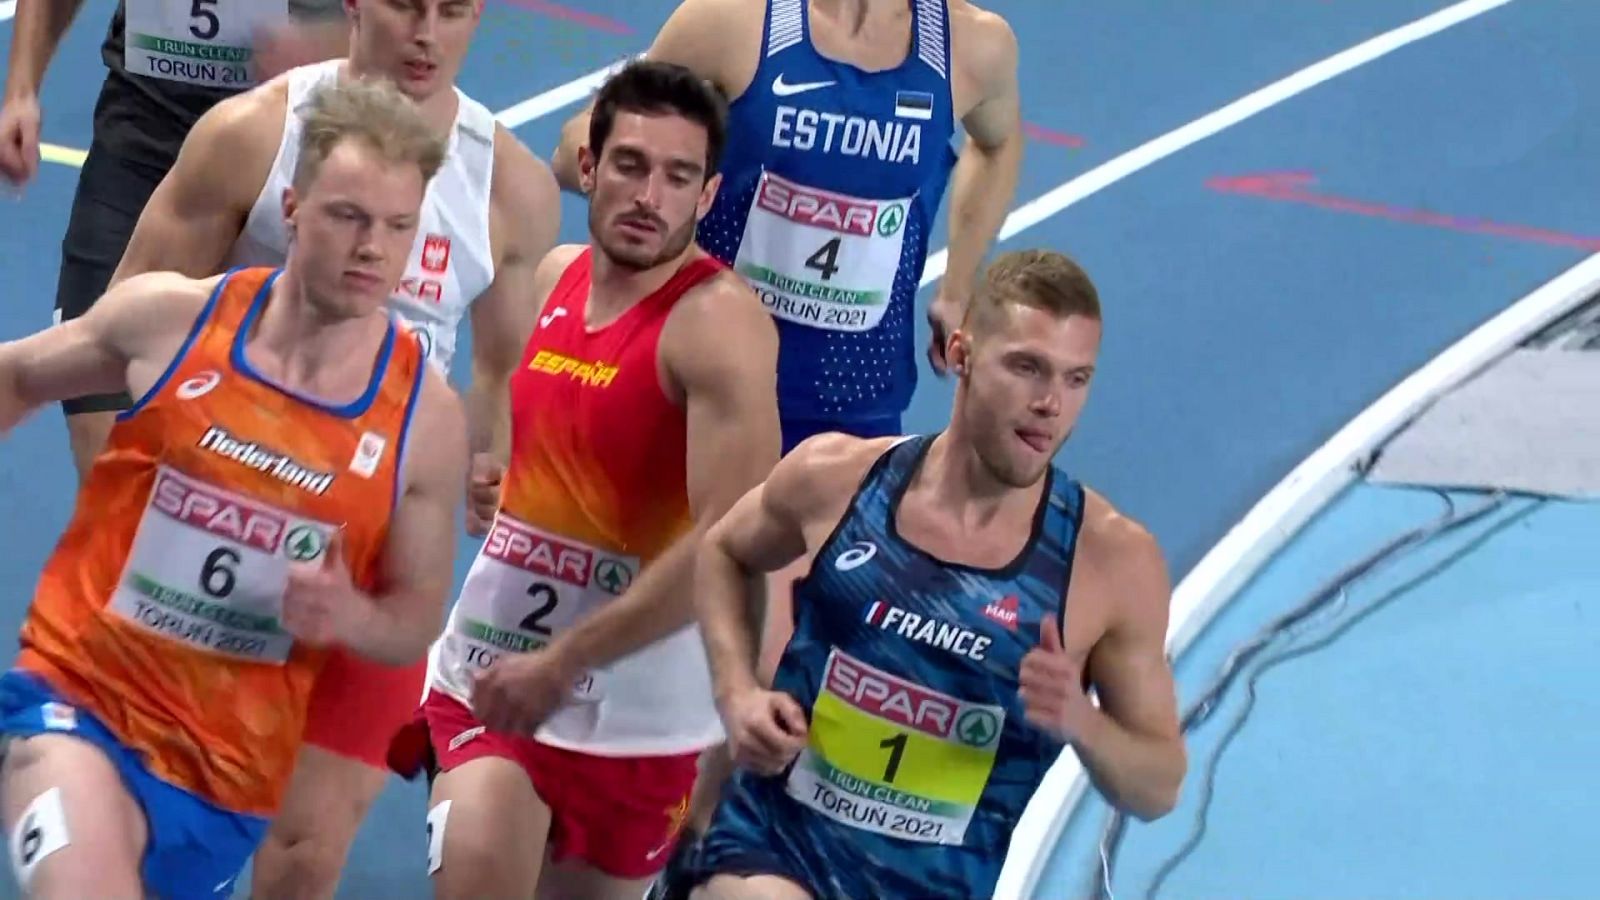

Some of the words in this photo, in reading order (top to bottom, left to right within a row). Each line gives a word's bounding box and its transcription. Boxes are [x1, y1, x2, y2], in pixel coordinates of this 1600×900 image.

[188, 0, 220, 40] 5
[164, 41, 195, 54] RUN
[221, 67, 248, 82] 20
[772, 106, 921, 165] ESTONIA
[762, 183, 874, 233] SPAR
[805, 237, 842, 281] 4
[775, 275, 806, 294] RUN
[809, 286, 858, 304] CLEAN
[824, 309, 867, 326] 2021
[528, 350, 619, 388] ESPAÑA
[153, 479, 283, 552] SPAR
[201, 546, 241, 599] 6
[486, 527, 588, 581] SPAR
[518, 582, 559, 636] 2
[881, 606, 992, 661] FRANCE
[829, 659, 953, 733] SPAR
[879, 732, 908, 783] 1
[813, 783, 887, 826] TORUŃ
[890, 814, 944, 837] 2021
[835, 772, 870, 796] RUN
[874, 787, 932, 811] CLEAN
[18, 811, 43, 866] 6
